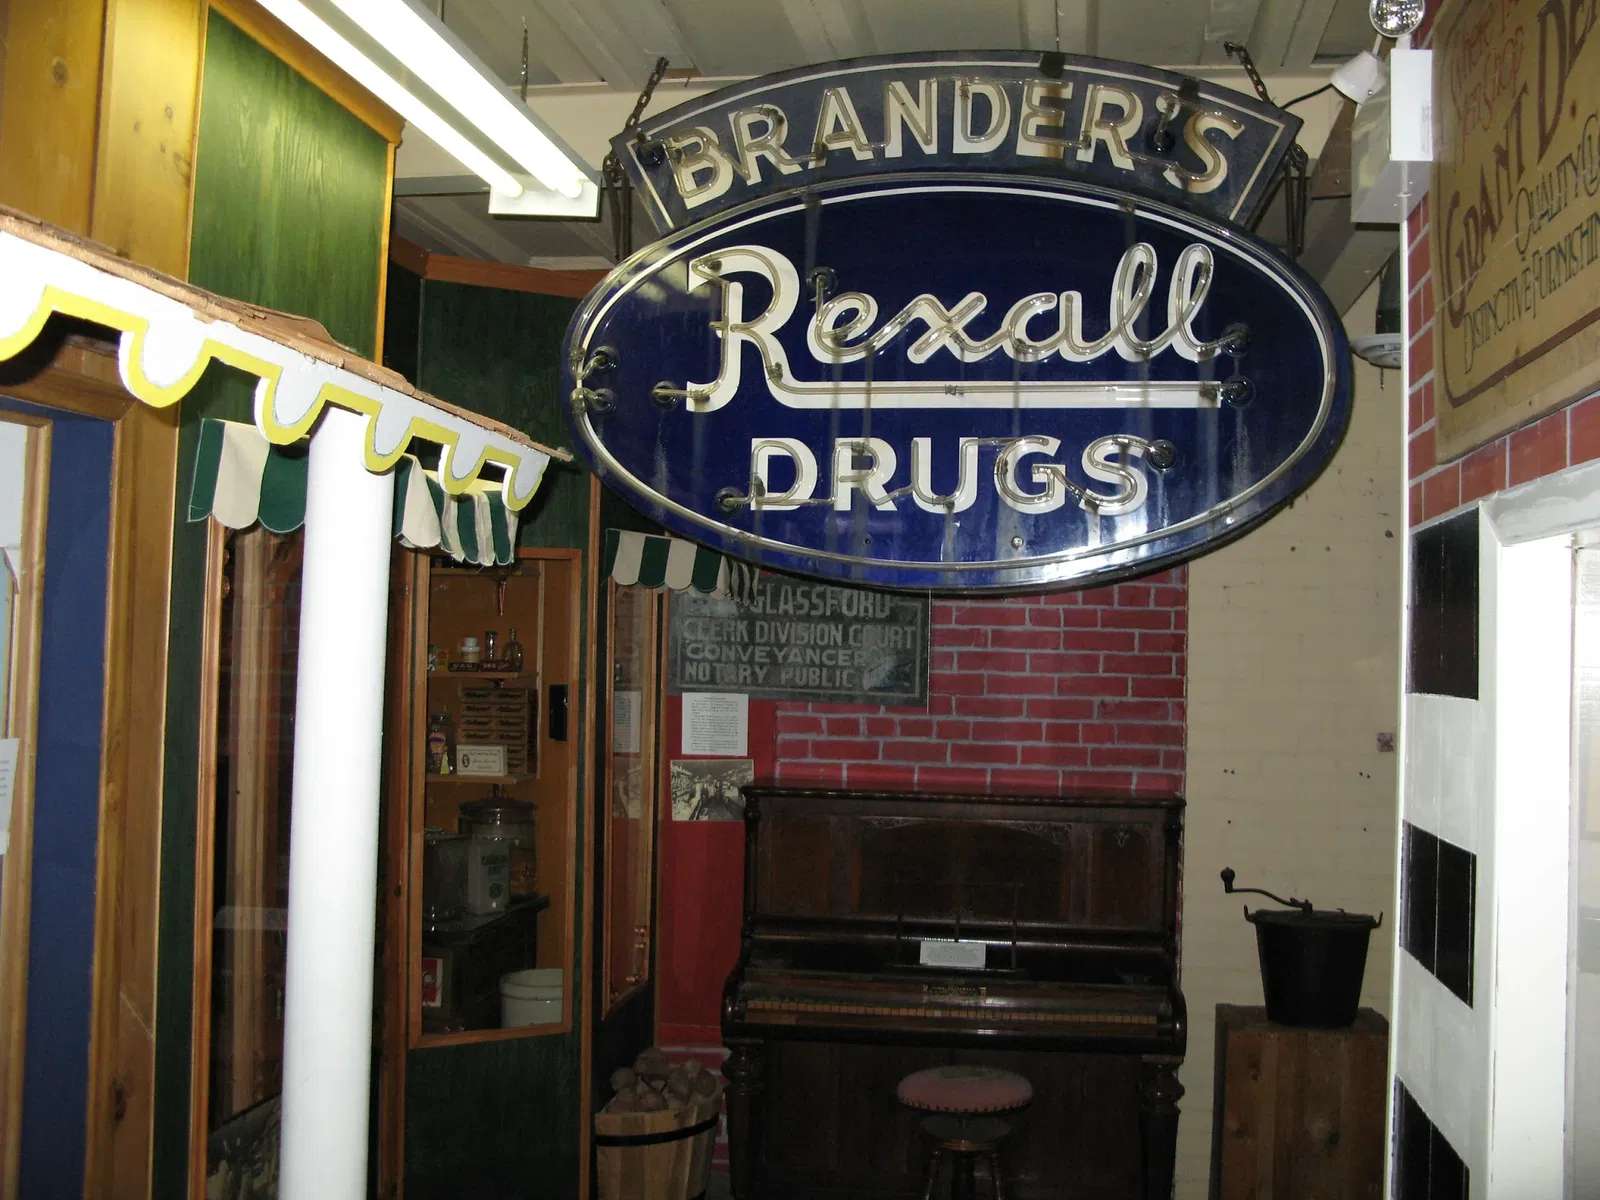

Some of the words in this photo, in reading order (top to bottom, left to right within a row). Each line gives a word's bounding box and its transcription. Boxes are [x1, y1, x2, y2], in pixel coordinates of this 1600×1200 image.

[664, 78, 1245, 210] BRANDER'S
[1516, 144, 1584, 256] QUALITY
[687, 242, 1222, 412] Rexall
[750, 434, 1149, 516] DRUGS
[755, 620, 843, 646] DIVISION
[781, 665, 857, 688] PUBLIC
